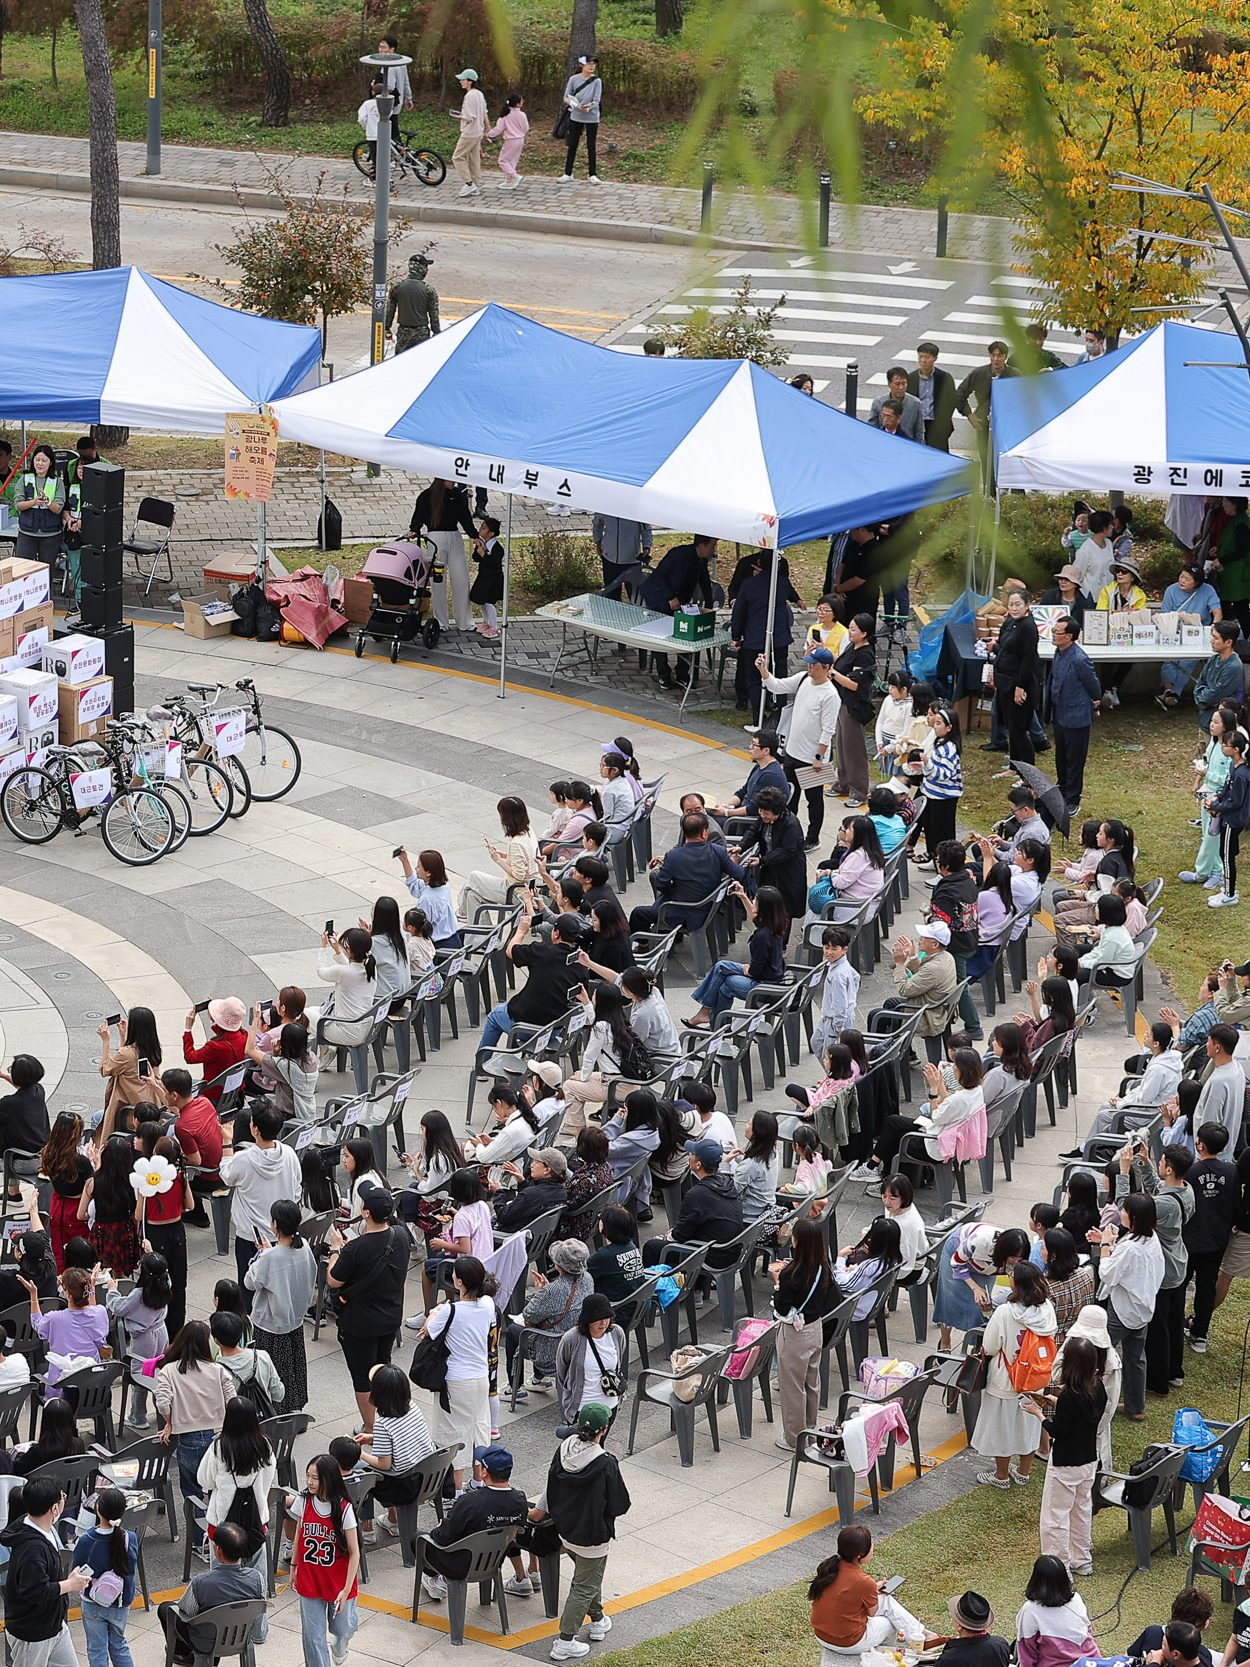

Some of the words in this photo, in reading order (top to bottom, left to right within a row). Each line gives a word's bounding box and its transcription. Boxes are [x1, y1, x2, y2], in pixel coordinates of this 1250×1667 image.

[1198, 1174, 1227, 1185] FILA
[302, 1522, 337, 1543] BULLS
[303, 1537, 336, 1567] 23
